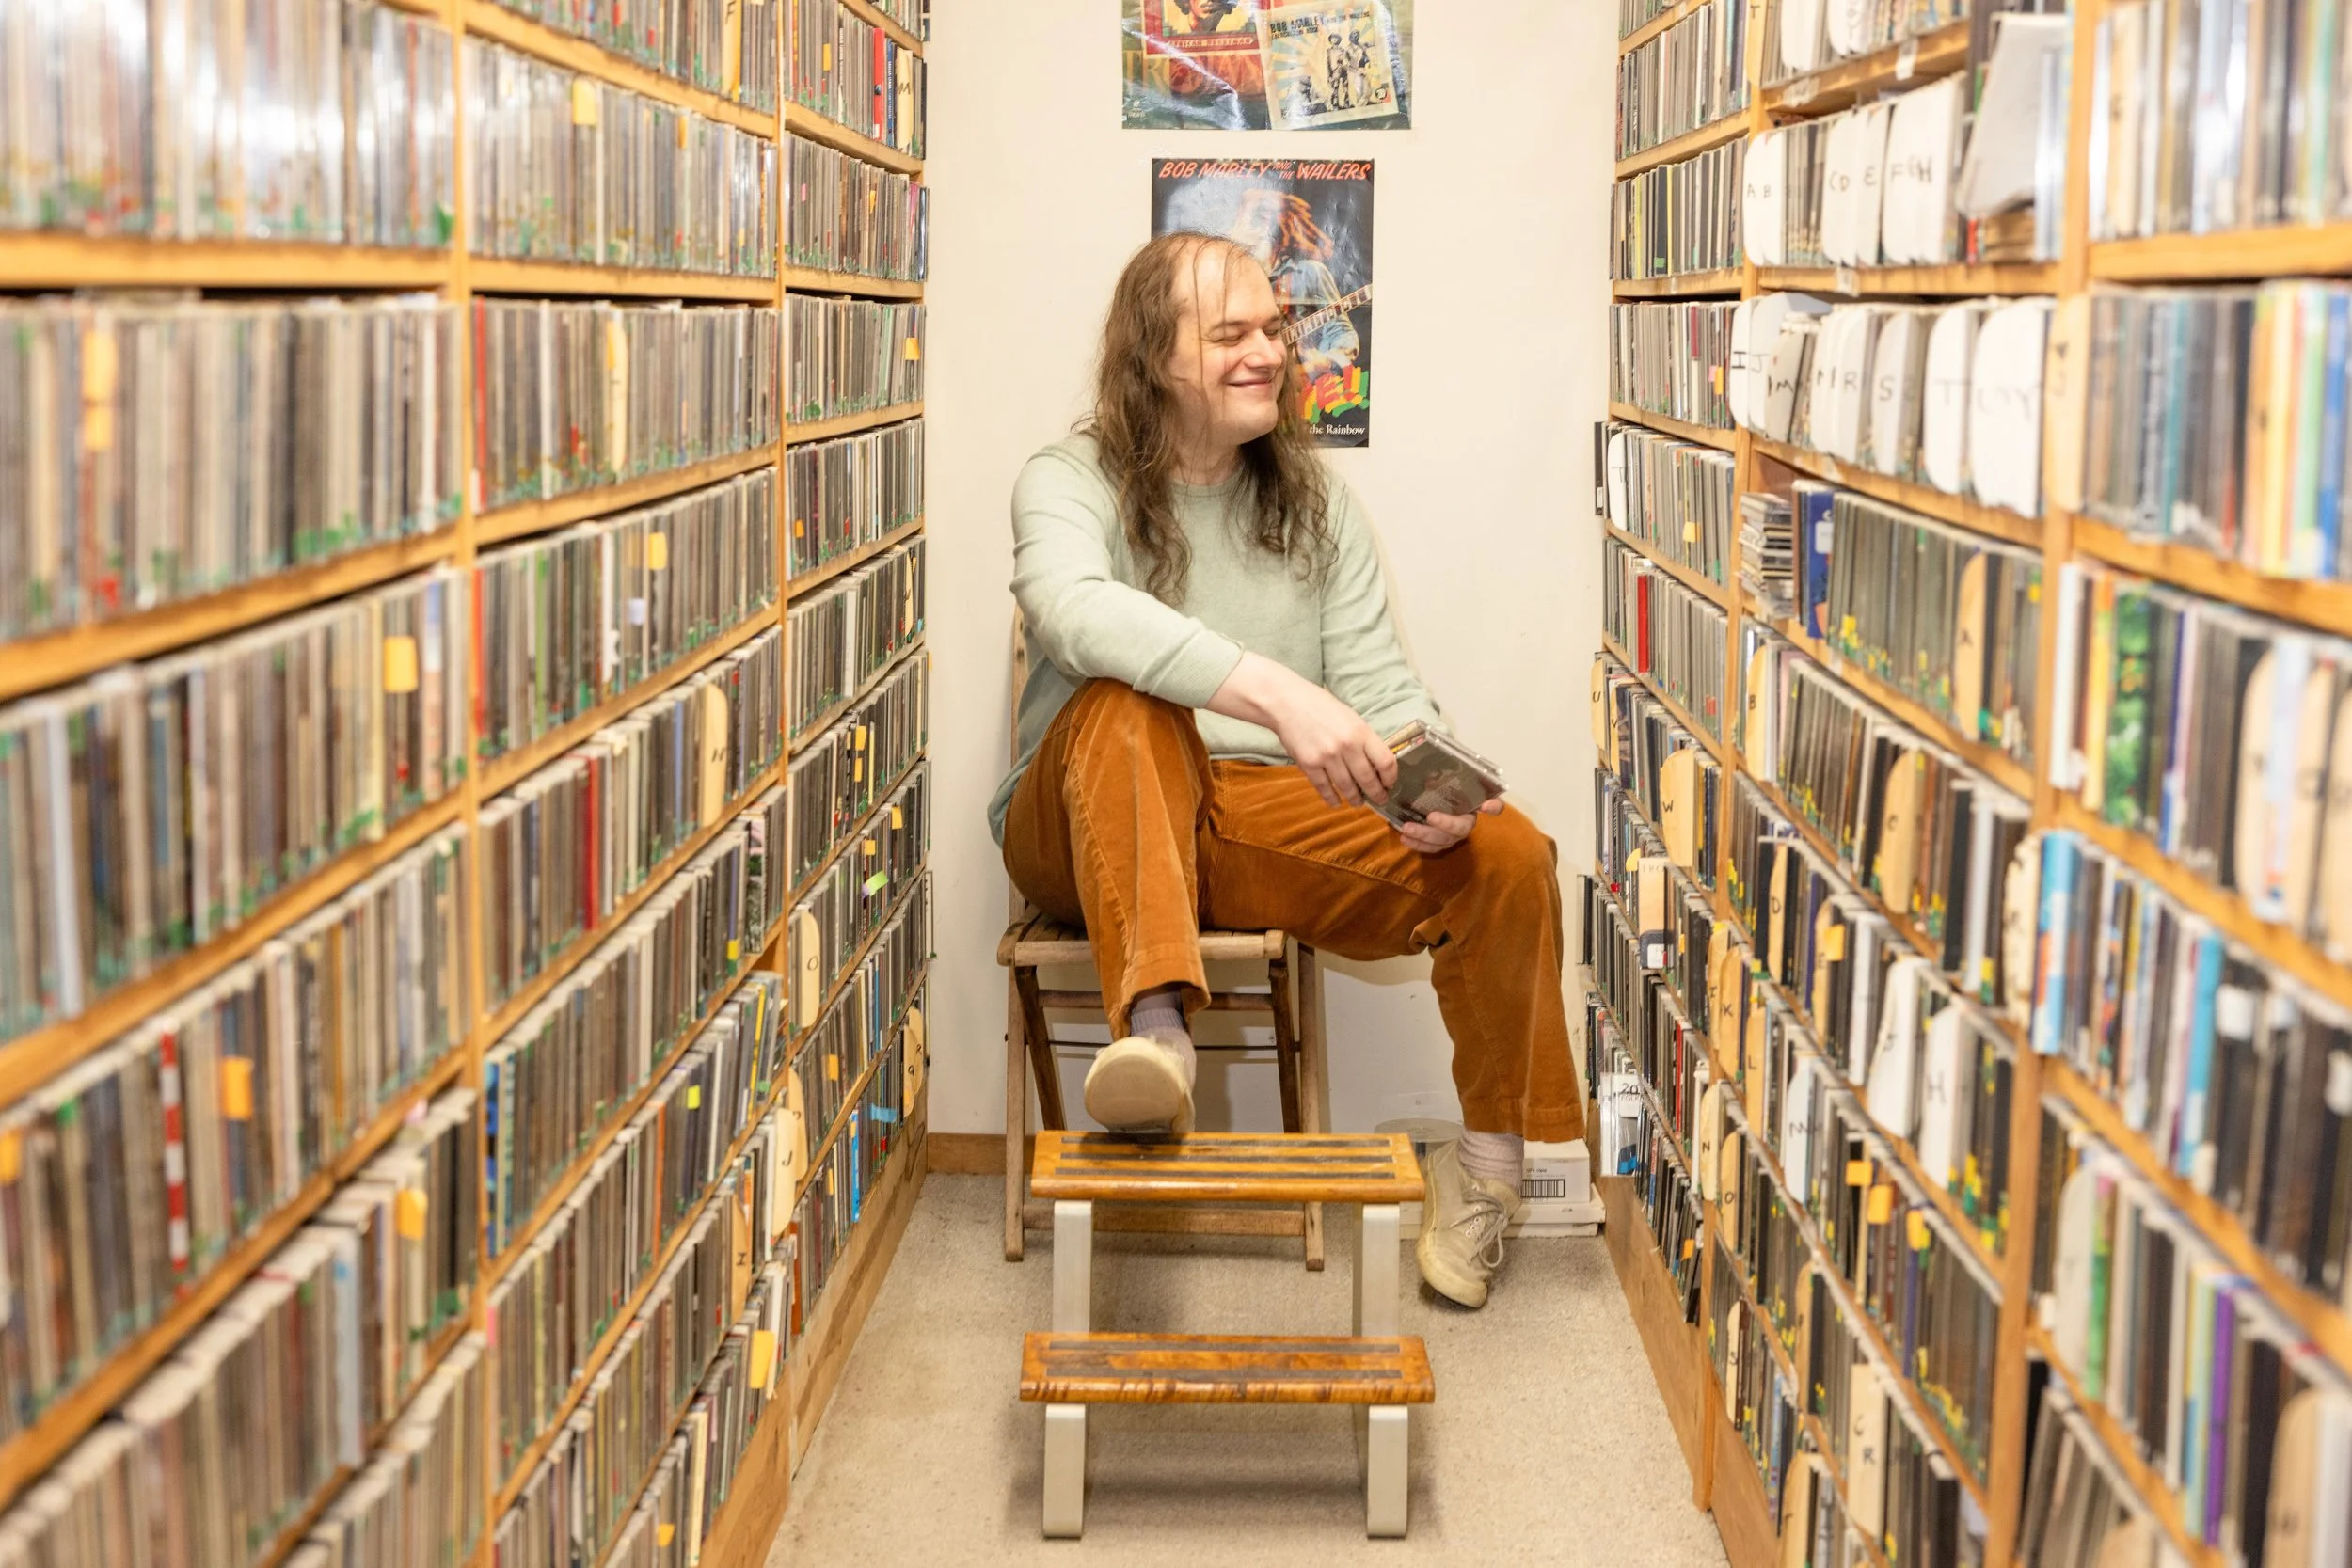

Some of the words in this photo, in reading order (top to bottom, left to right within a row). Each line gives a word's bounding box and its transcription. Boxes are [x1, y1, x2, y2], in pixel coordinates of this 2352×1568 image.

[1270, 21, 1287, 33] BOB
[1158, 161, 1198, 179] BOB
[1198, 161, 1271, 179] MARLEY
[1272, 160, 1292, 170] AND
[1296, 162, 1372, 180] WAILERS
[1310, 423, 1325, 435] the
[1326, 423, 1366, 435] Rainbow
[1662, 799, 1674, 813] W
[1702, 1140, 1711, 1154] N
